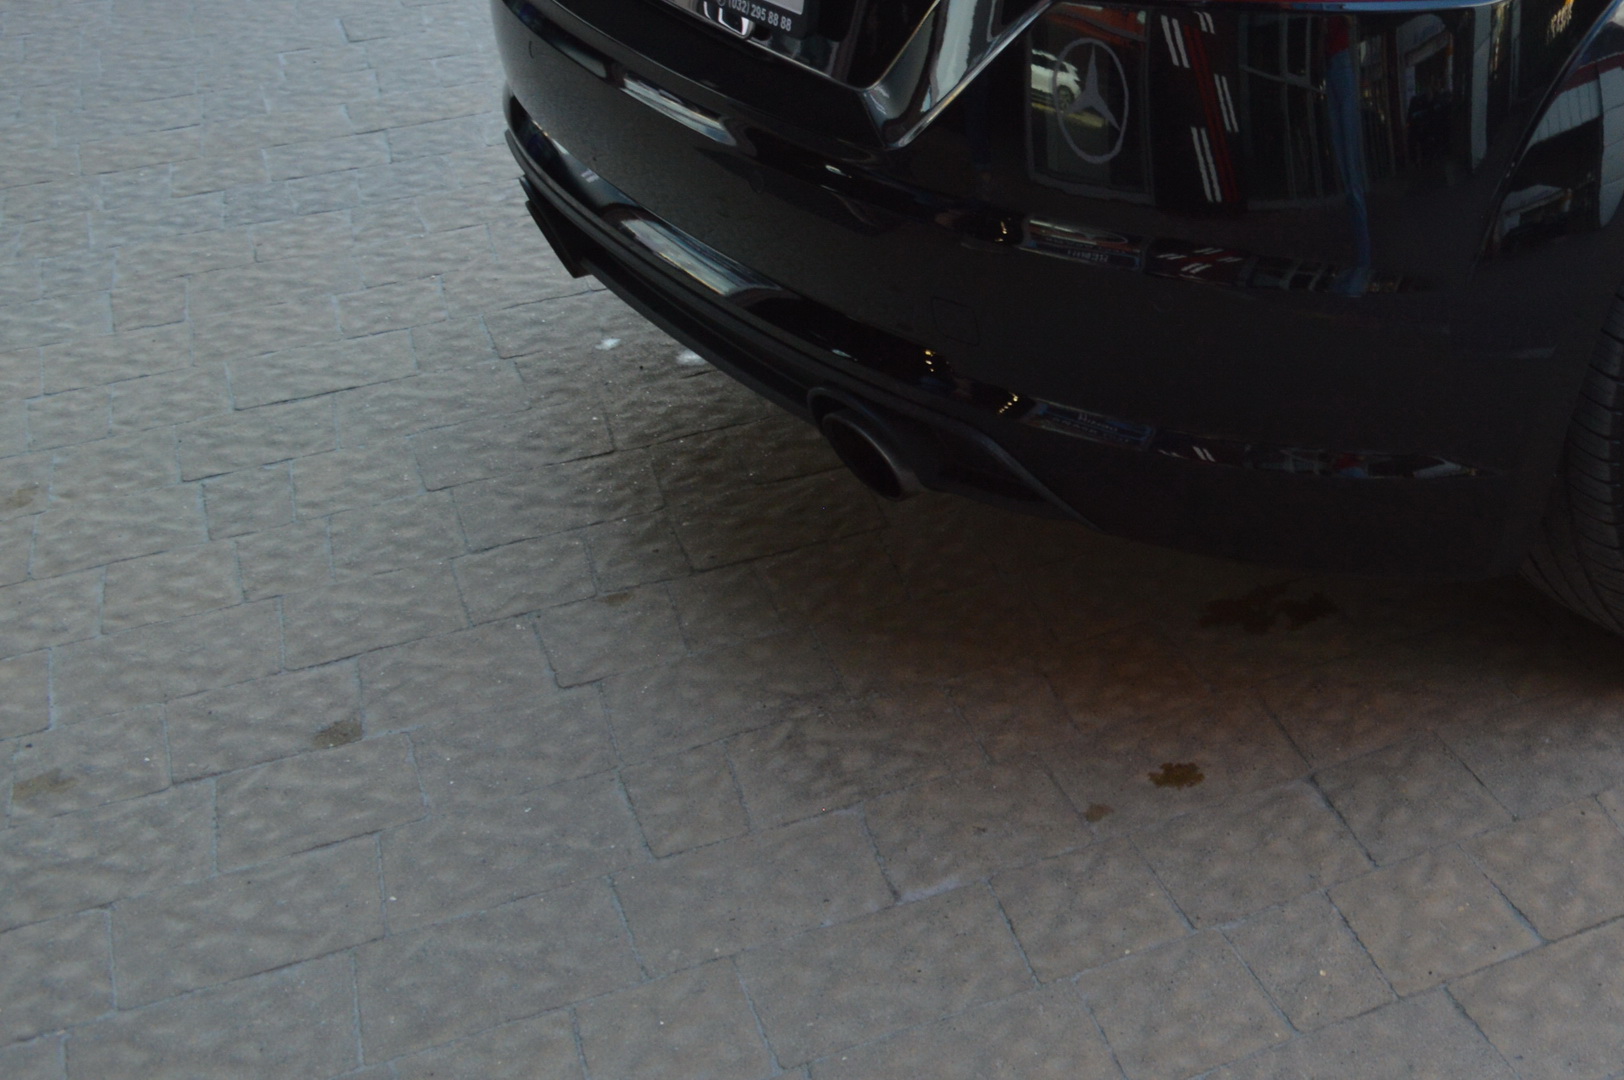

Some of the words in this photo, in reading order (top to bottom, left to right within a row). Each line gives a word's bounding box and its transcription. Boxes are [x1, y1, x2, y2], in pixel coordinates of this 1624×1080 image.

[751, 4, 766, 21] 295
[767, 11, 780, 27] 88
[780, 16, 793, 32] 88
